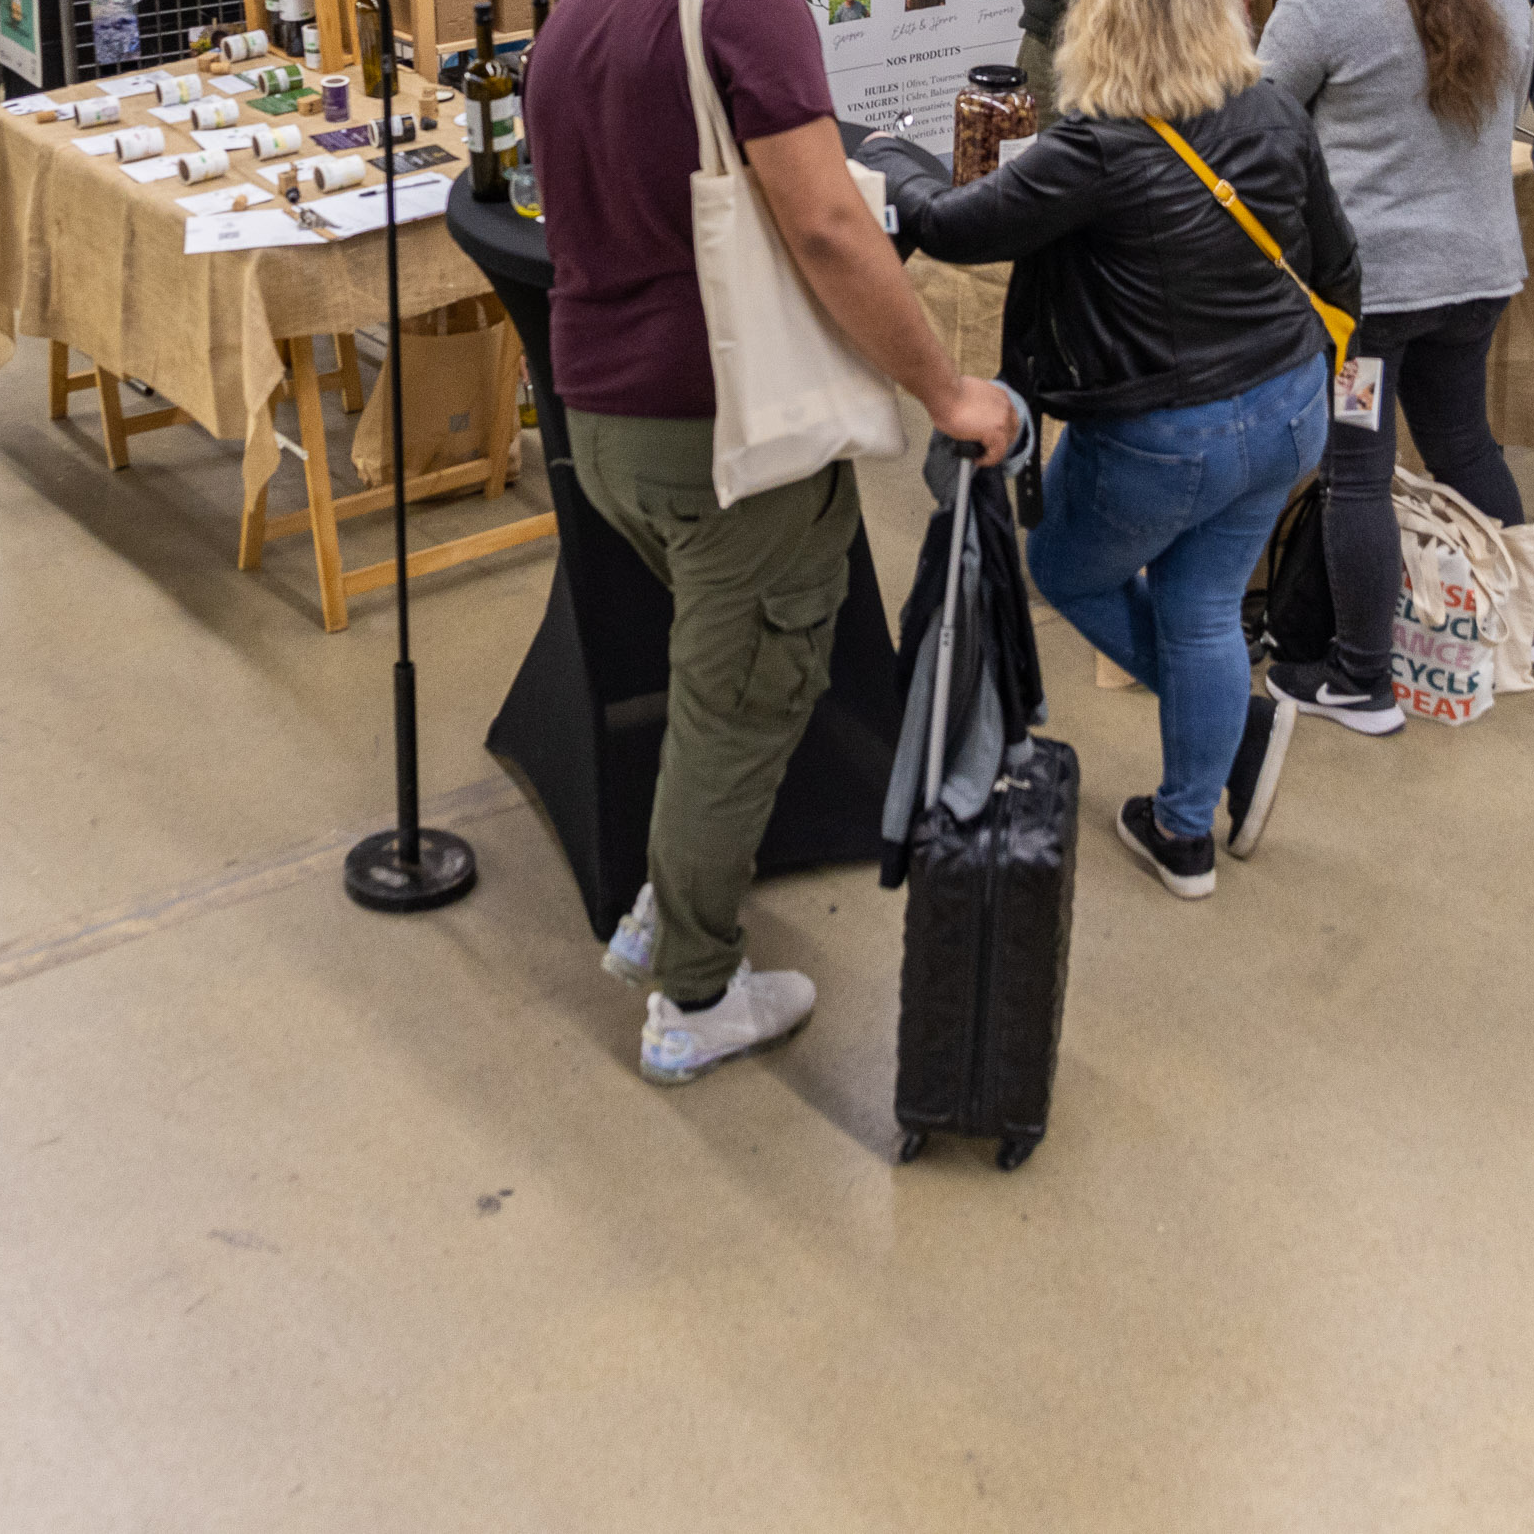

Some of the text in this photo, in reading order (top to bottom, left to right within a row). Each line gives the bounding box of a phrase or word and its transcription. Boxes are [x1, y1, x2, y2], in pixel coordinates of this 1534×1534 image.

[886, 46, 962, 68] NOS PRODUITS
[864, 82, 899, 97] HUILES
[906, 78, 929, 90] Olive,
[847, 96, 899, 113] VINAIGRES
[906, 91, 929, 102] Cidre,
[865, 109, 899, 123] OLIVES
[1392, 627, 1476, 670] ANCE
[1390, 653, 1481, 696] CYCLE
[1392, 682, 1476, 720] PEAT
